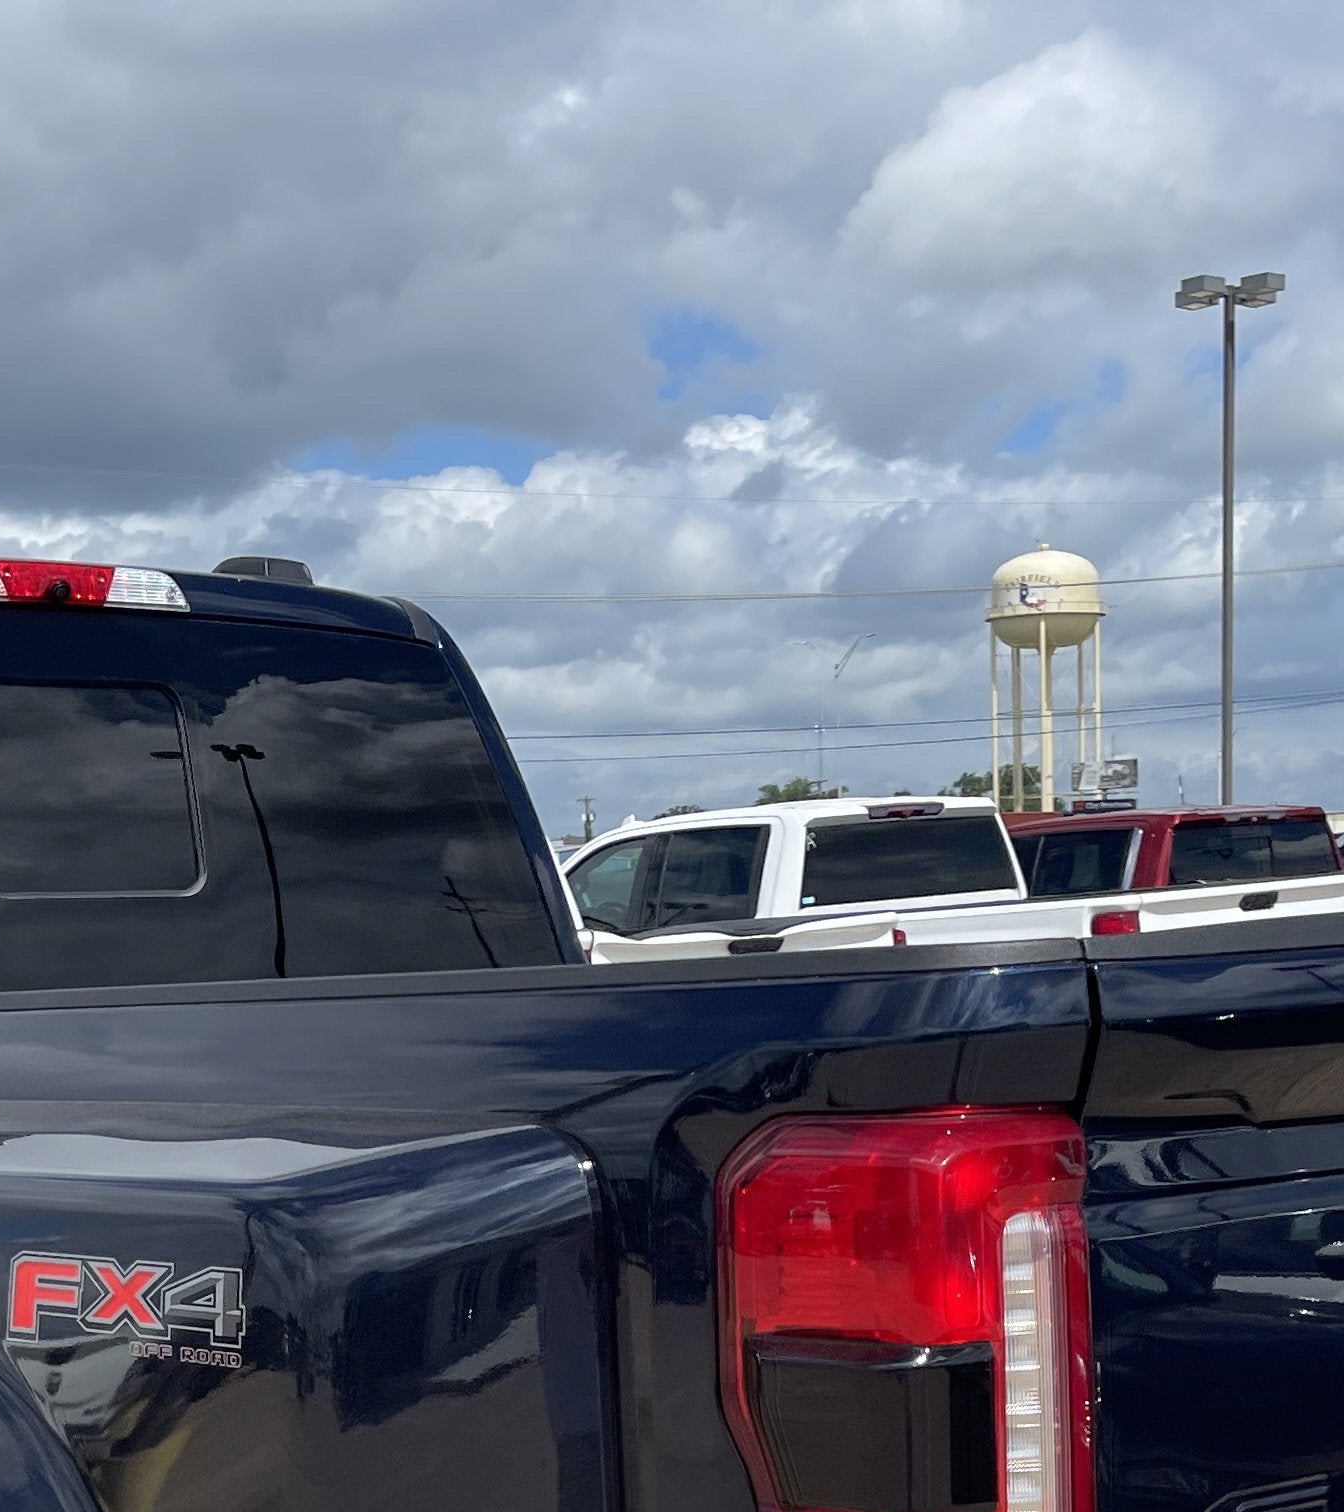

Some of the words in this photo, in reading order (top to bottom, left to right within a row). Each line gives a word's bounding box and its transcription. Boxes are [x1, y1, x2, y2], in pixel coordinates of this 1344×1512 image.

[6, 1250, 246, 1349] FX4
[129, 1341, 173, 1361] OFF
[179, 1346, 243, 1369] ROAD
